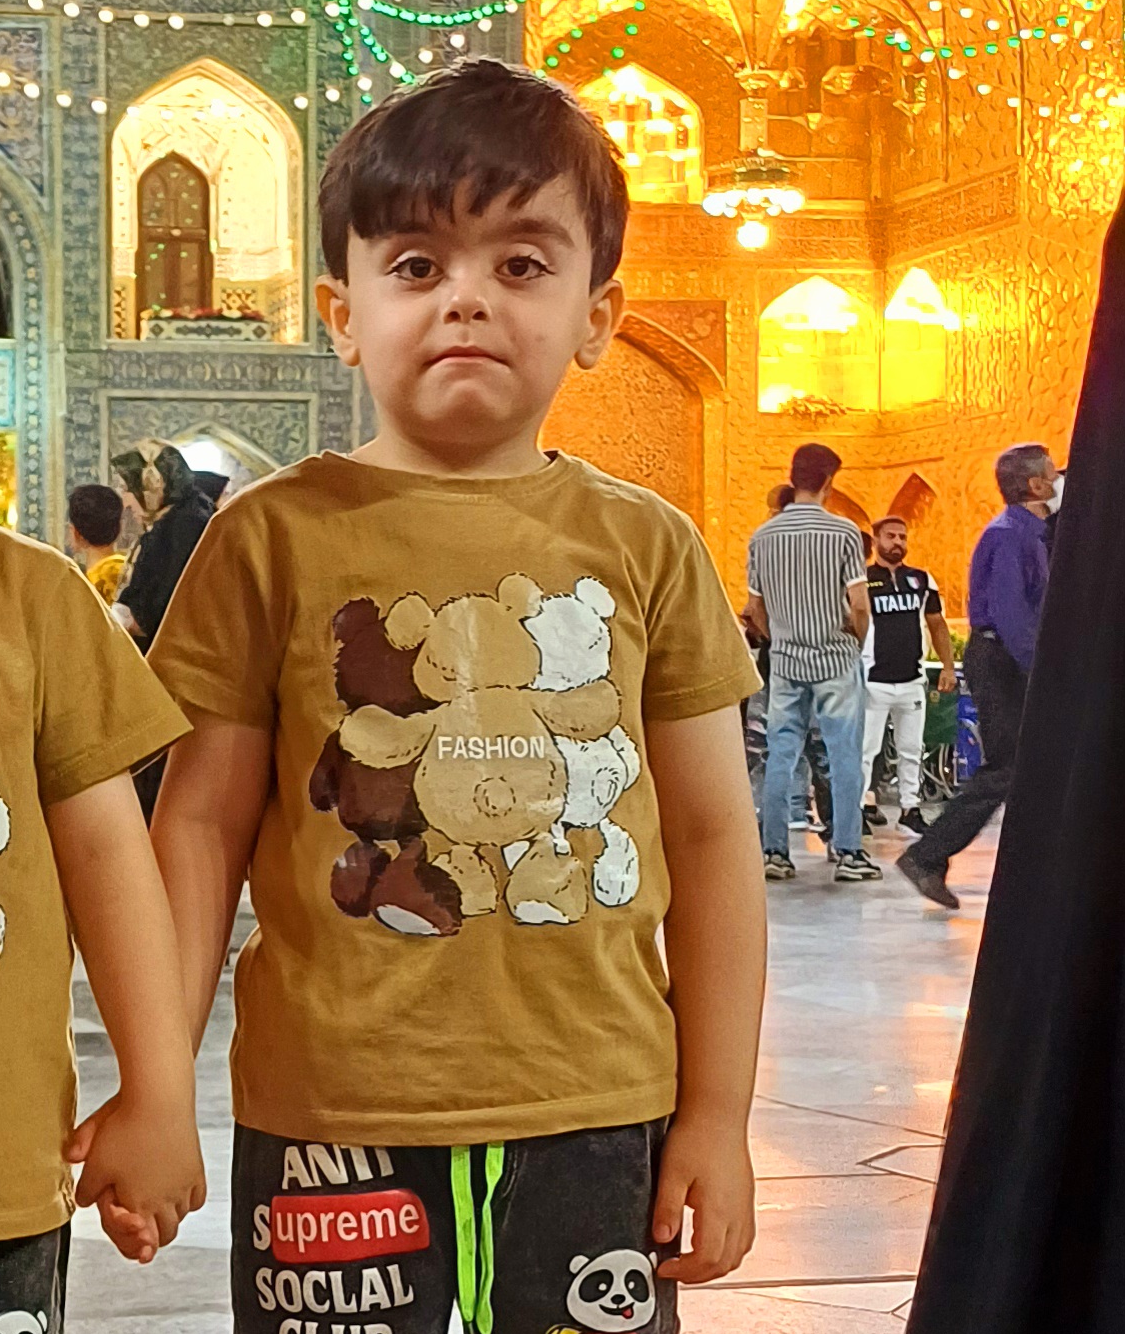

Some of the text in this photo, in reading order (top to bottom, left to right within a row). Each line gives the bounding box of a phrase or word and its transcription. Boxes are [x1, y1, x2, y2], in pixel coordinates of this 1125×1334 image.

[874, 593, 921, 614] ITALIA
[437, 735, 546, 760] FASHION
[281, 1143, 395, 1190] ANTI
[253, 1201, 420, 1253] Supreme
[255, 1264, 414, 1314] SOCLAL
